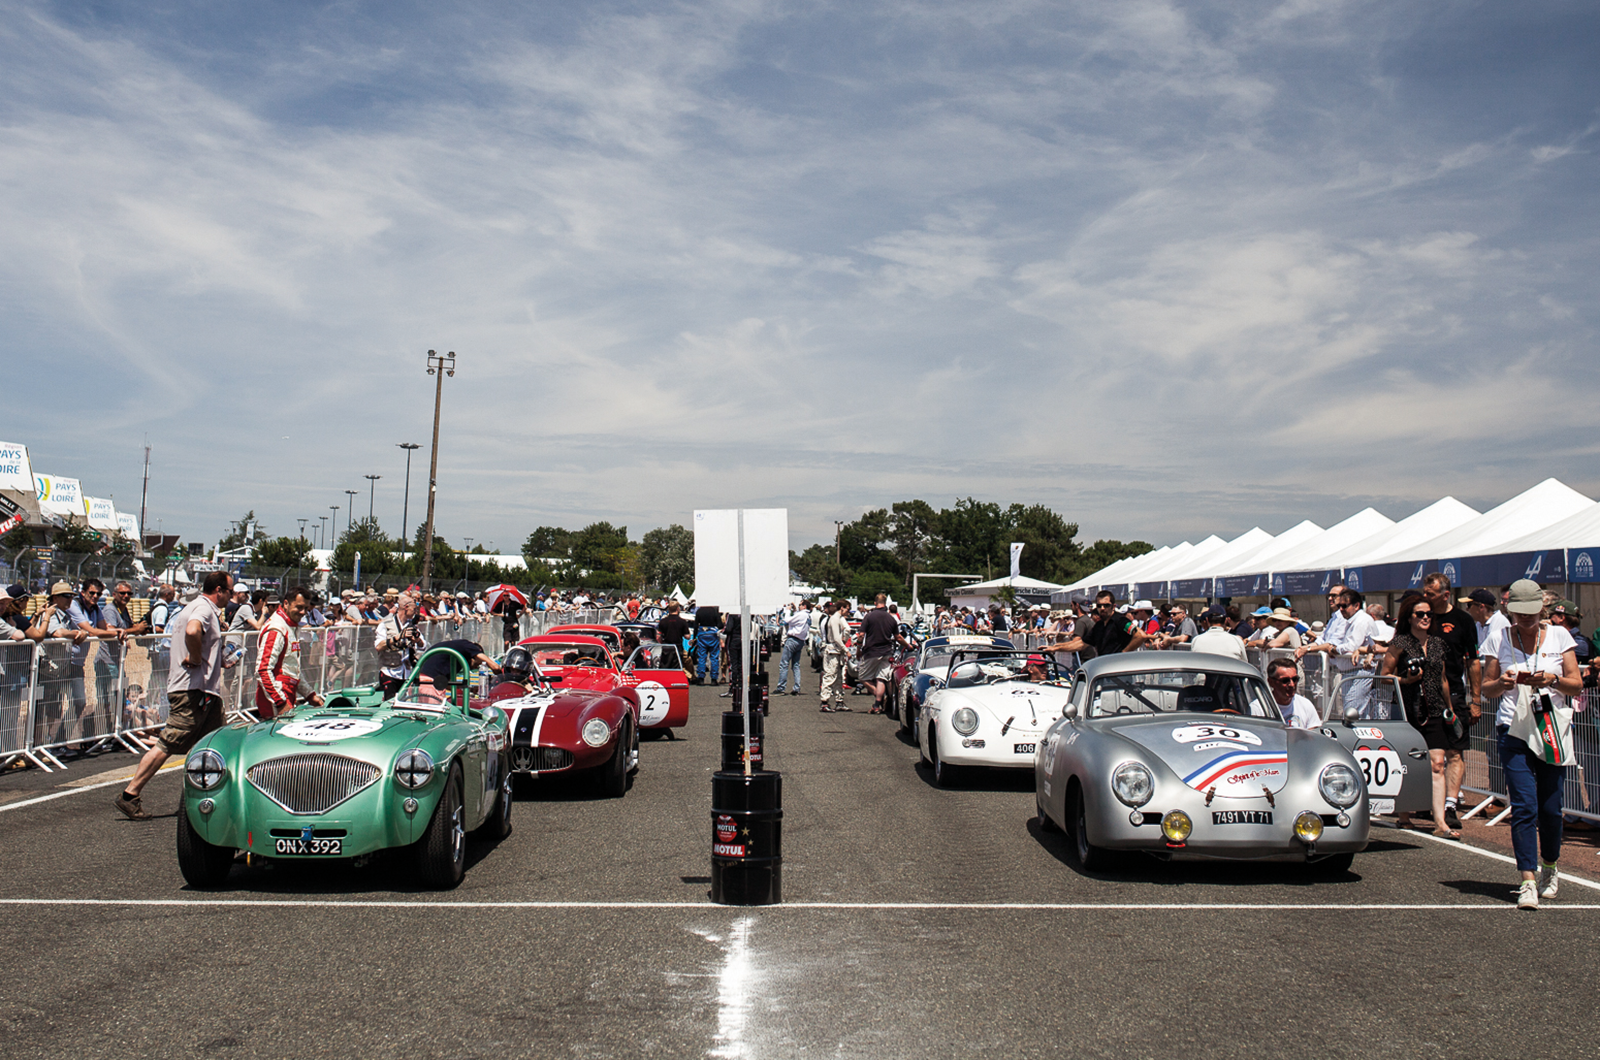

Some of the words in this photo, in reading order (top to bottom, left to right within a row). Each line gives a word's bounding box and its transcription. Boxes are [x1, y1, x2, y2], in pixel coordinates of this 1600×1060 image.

[0, 450, 21, 459] AYS
[56, 483, 76, 491] PAYS
[52, 494, 75, 503] LOIRE
[91, 512, 110, 520] LOIRE
[644, 694, 656, 711] 2
[1197, 727, 1241, 738] 30
[1017, 744, 1034, 753] 406
[1216, 811, 1239, 824] 7491
[1242, 811, 1256, 823] YT
[1258, 811, 1269, 823] 71
[717, 824, 737, 832] MOTUL
[276, 839, 309, 853] ONX
[310, 839, 341, 853] 392
[714, 844, 744, 855] MOTUL
